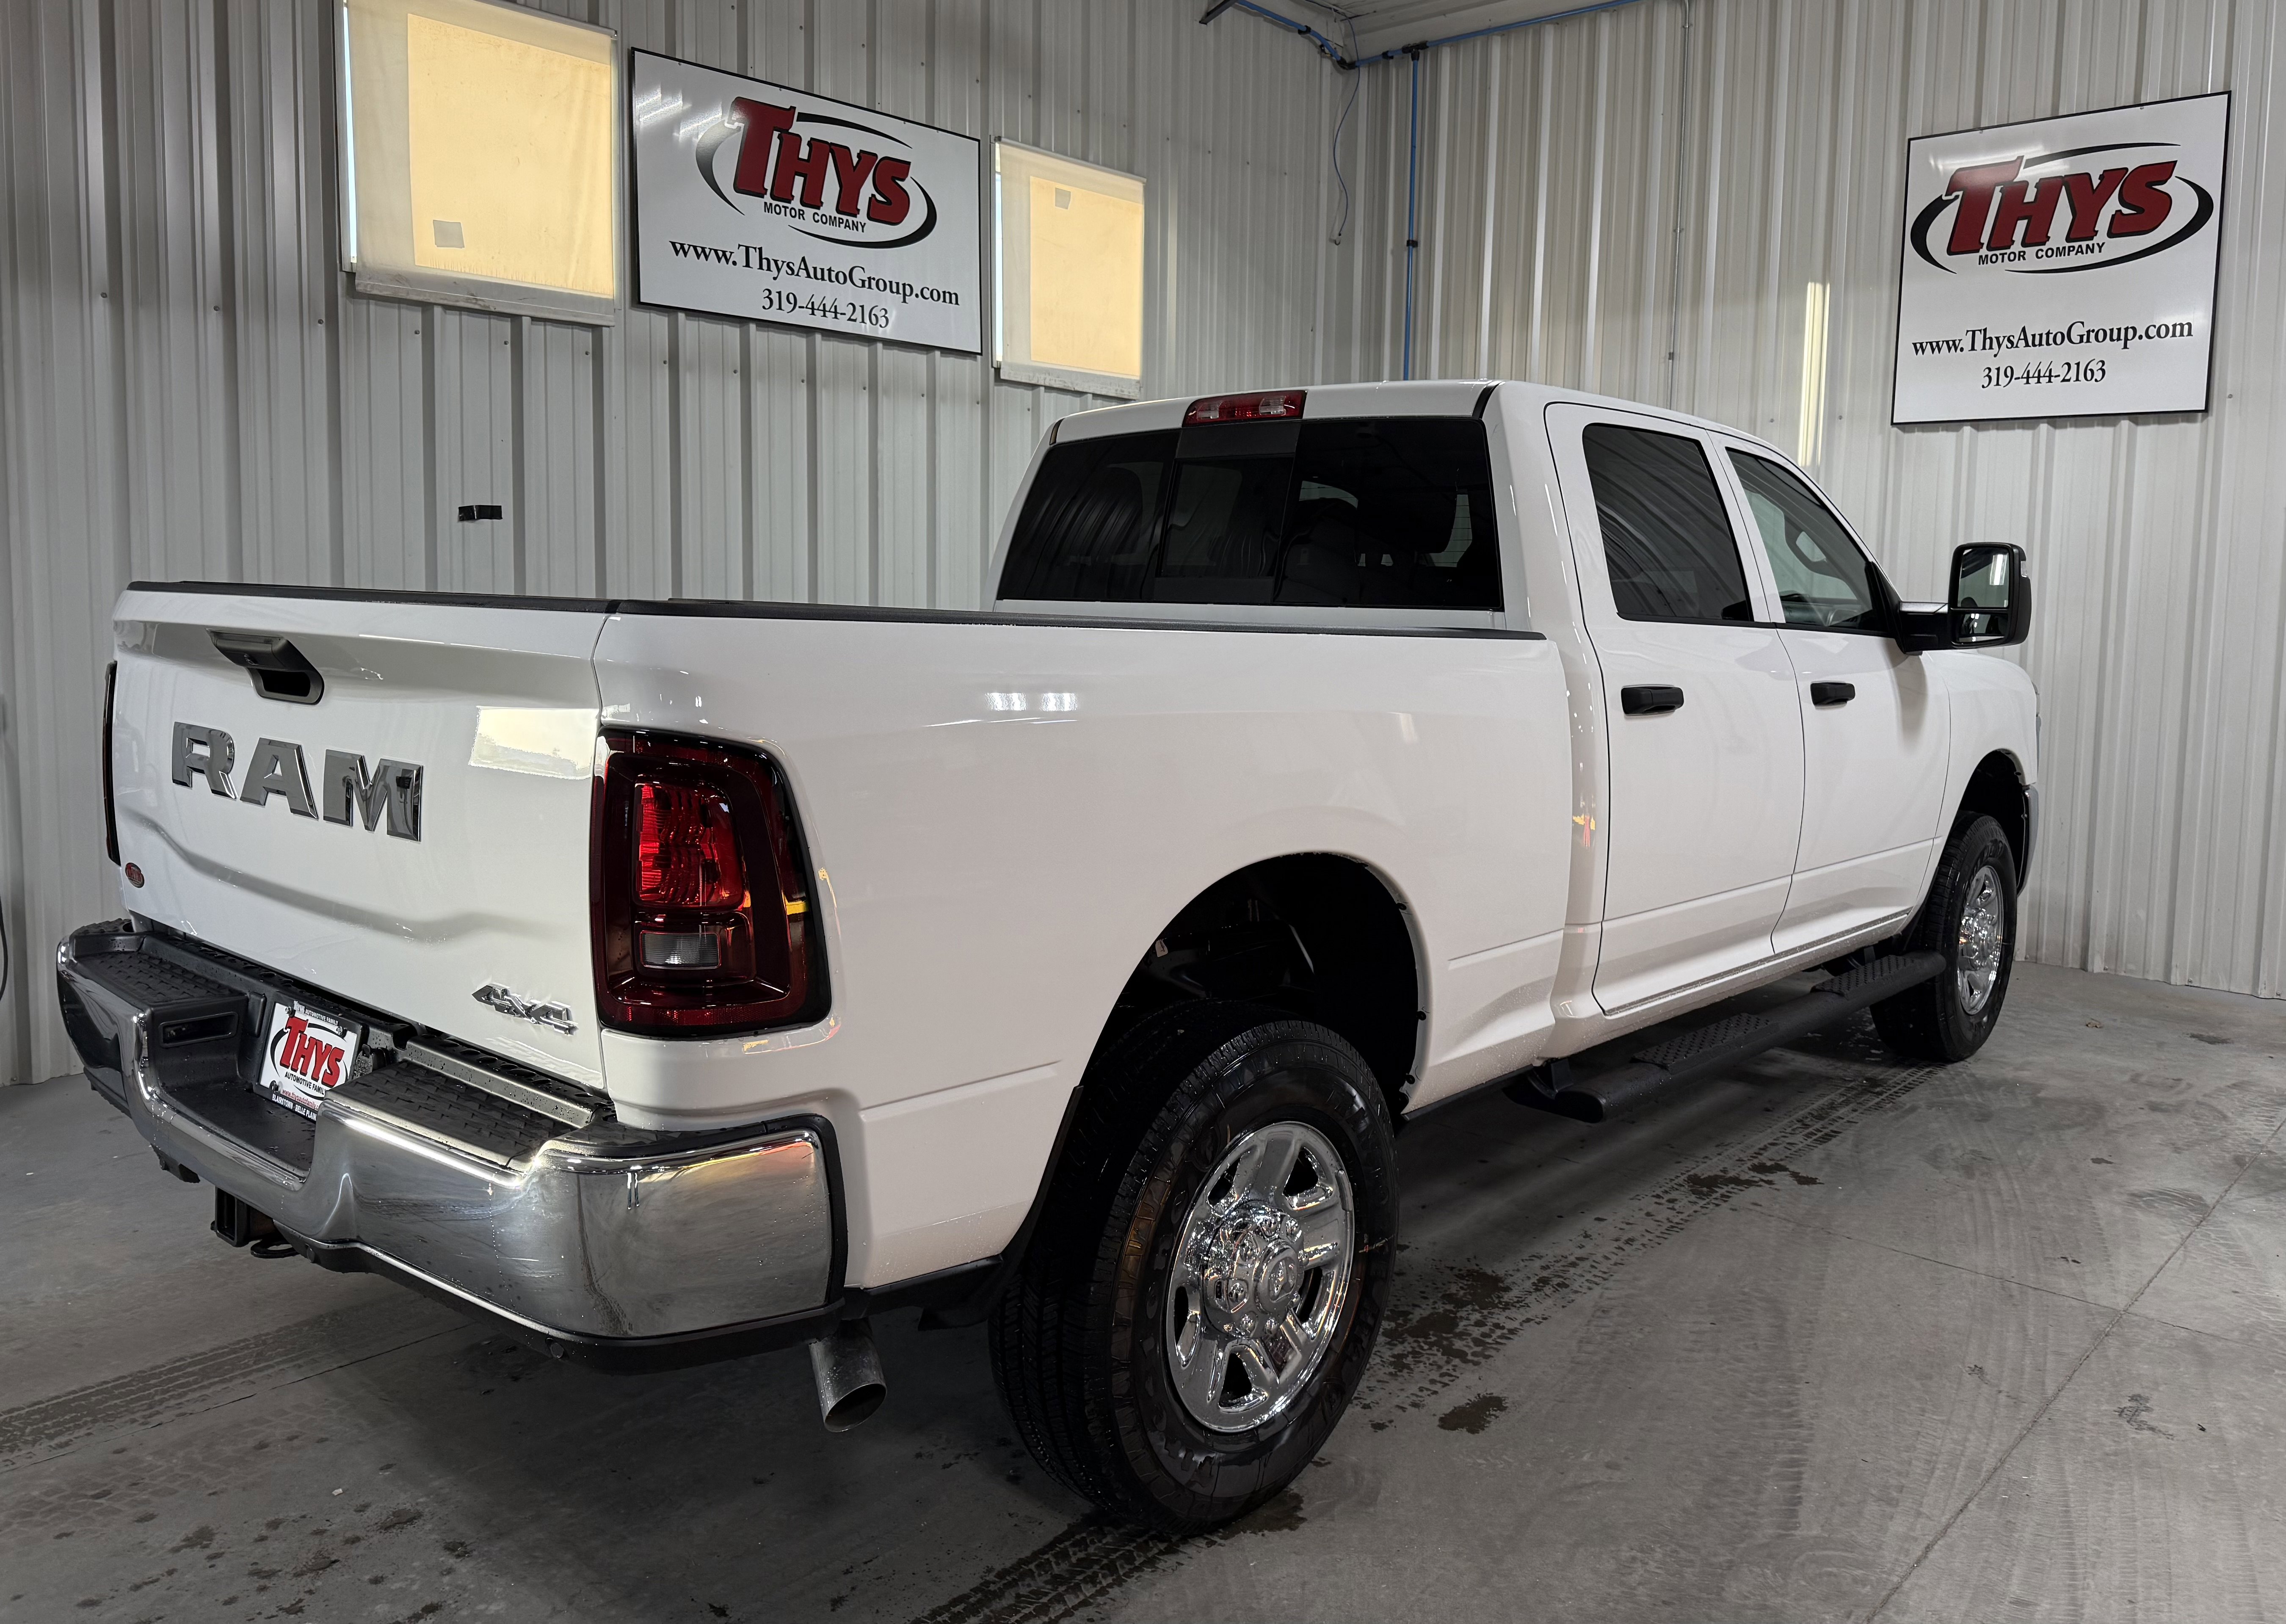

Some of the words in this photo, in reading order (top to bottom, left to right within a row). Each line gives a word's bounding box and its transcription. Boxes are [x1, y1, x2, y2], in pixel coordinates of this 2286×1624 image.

[726, 96, 911, 226] THYS
[764, 202, 805, 221] MOTOR
[812, 212, 866, 232] COMPANY
[1945, 155, 2178, 256] THYS
[1978, 250, 2026, 265] MOTOR
[2035, 242, 2105, 259] COMPANY
[669, 240, 960, 305] www.ThysAutoGroup.com
[762, 288, 889, 329] 319-444-2163
[1912, 321, 2193, 357] www.ThysAutoGroup.com
[1982, 358, 2106, 389] 319-444-2163
[172, 721, 423, 842] RAM
[305, 1008, 326, 1022] AUTOMOTIVE
[326, 1016, 338, 1026] FAMILY
[280, 1016, 345, 1088] THYS
[284, 1071, 312, 1089] AUTOMOTIVE
[272, 1094, 293, 1110] BLAIRSTOWN
[295, 1104, 306, 1116] BELLE
